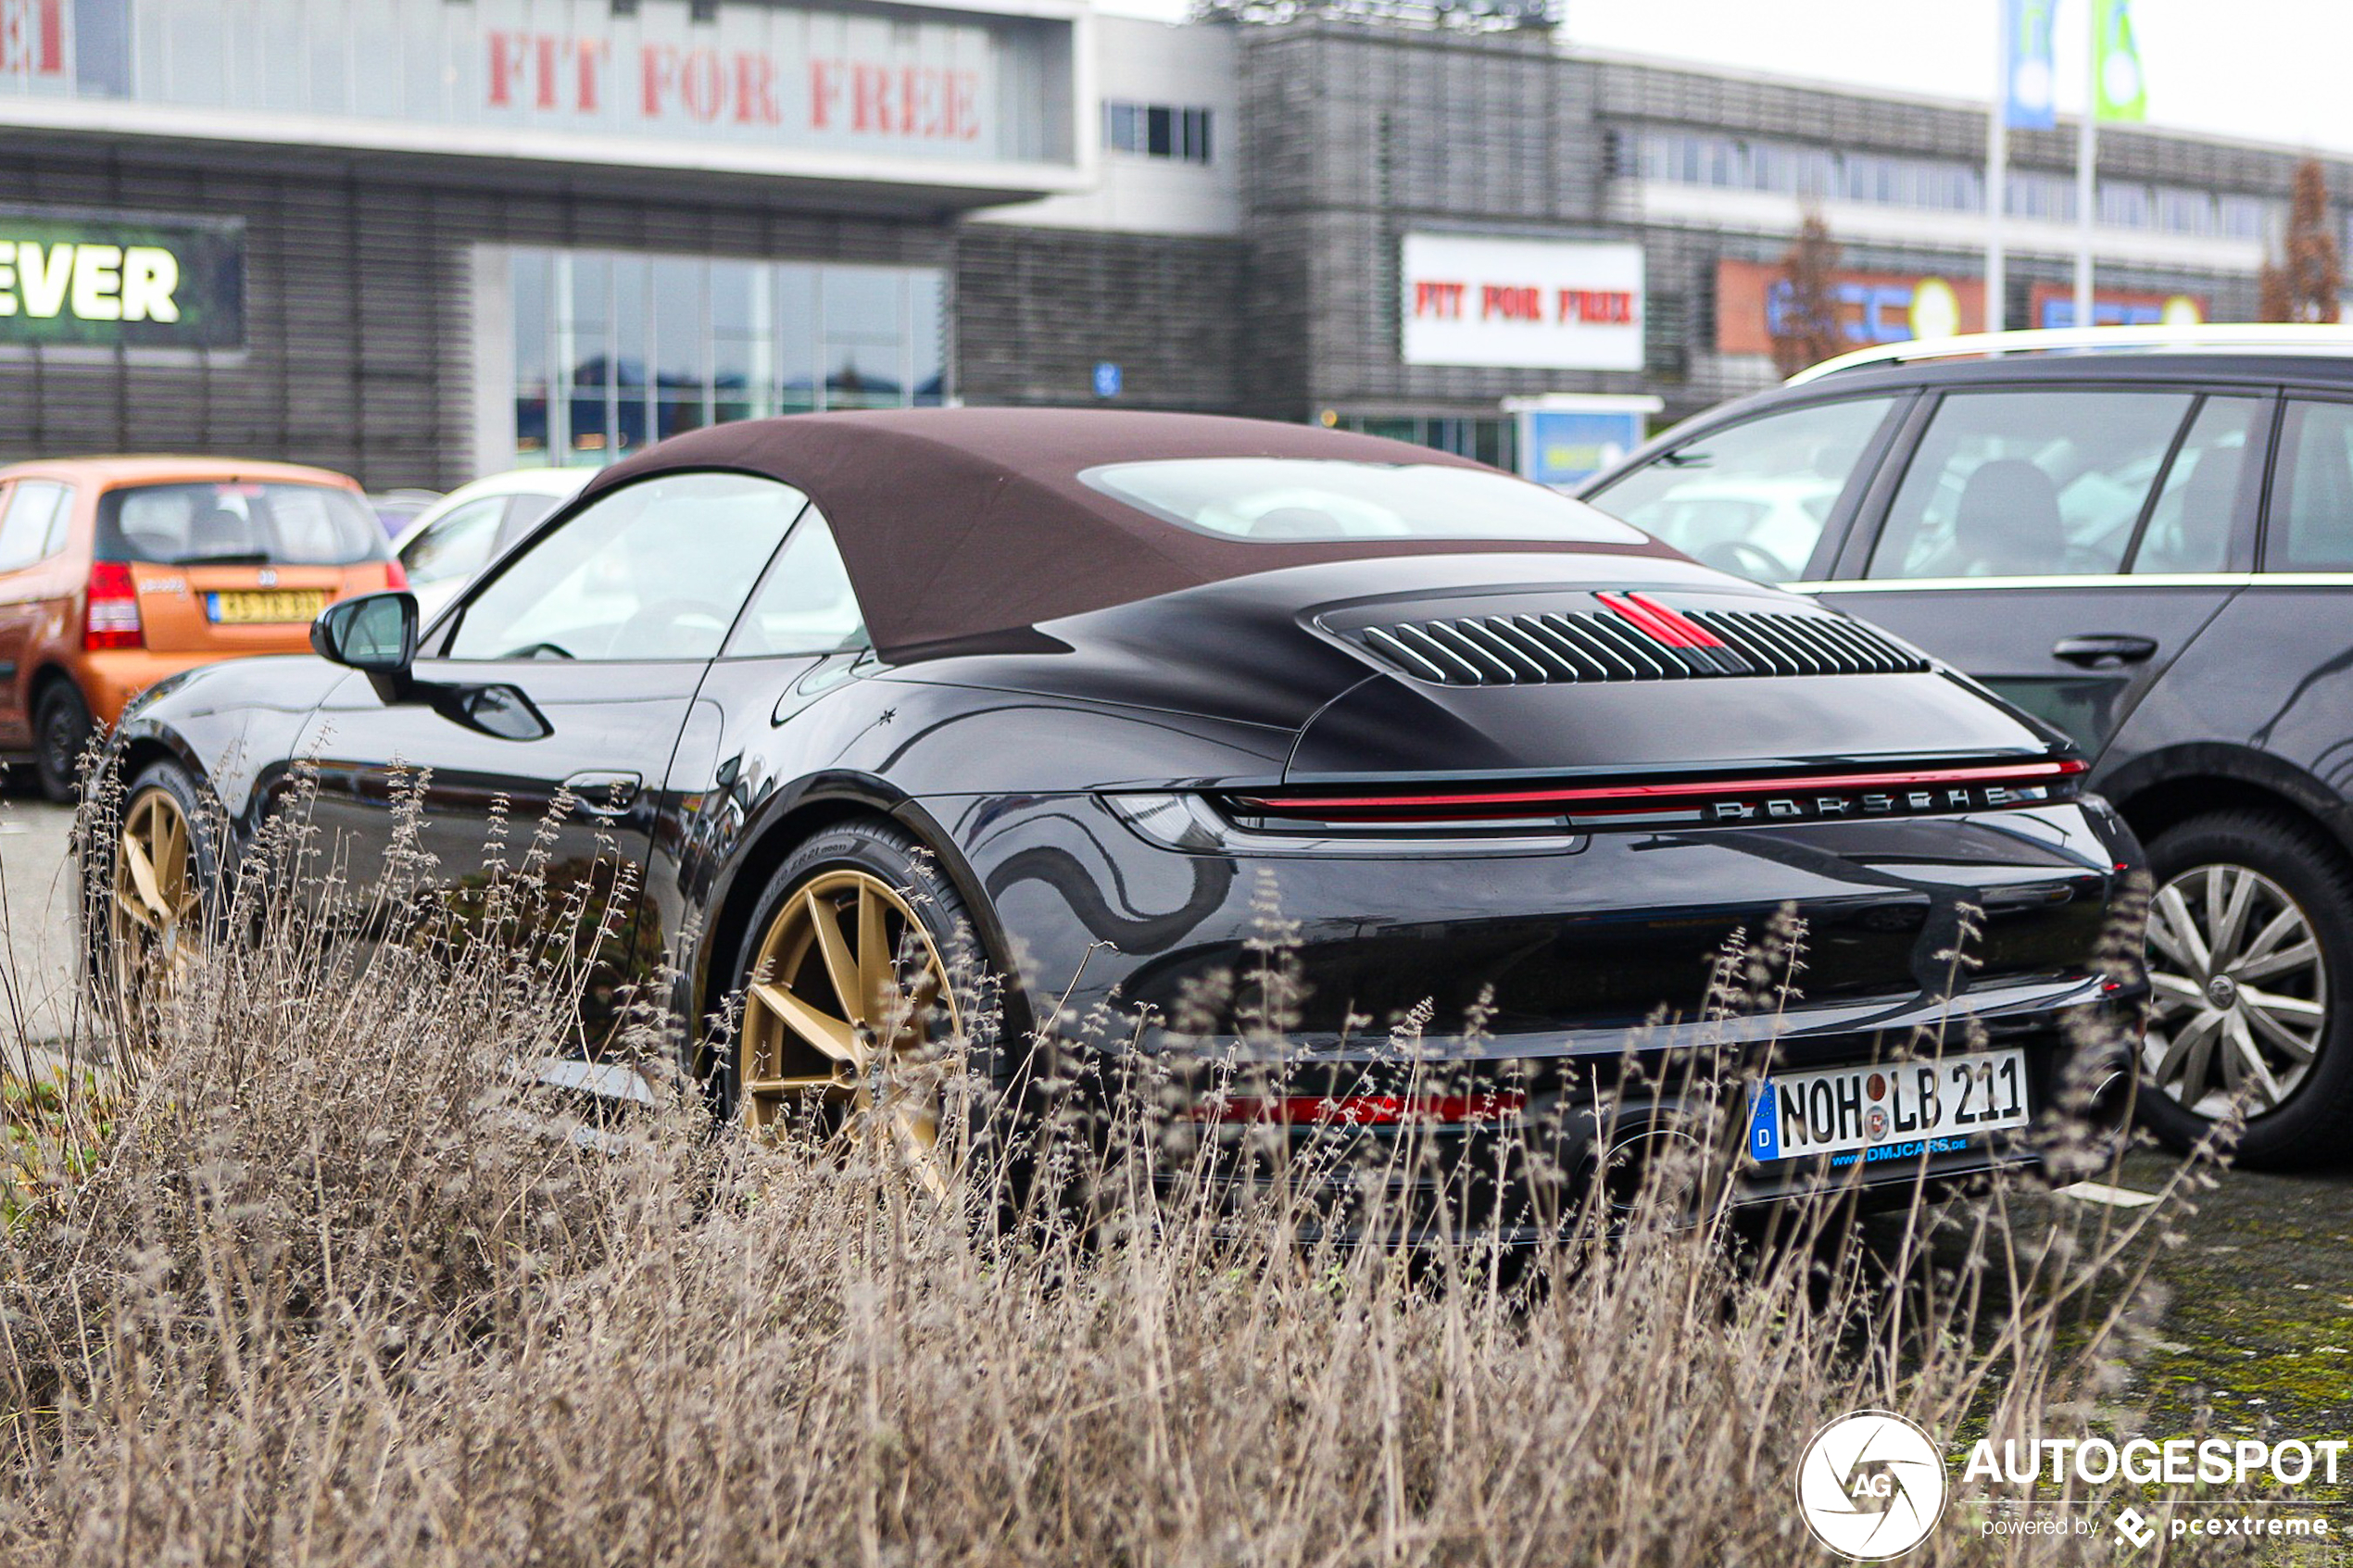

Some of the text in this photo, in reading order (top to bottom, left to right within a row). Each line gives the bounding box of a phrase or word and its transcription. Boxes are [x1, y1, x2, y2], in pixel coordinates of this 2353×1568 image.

[486, 31, 980, 140] FIT FOR FREE
[1416, 282, 1631, 324] FIT FOR FREE
[1714, 787, 2006, 821] PORSCHE
[1780, 1057, 2022, 1148] NOH LB 211
[1758, 1128, 1770, 1148] D
